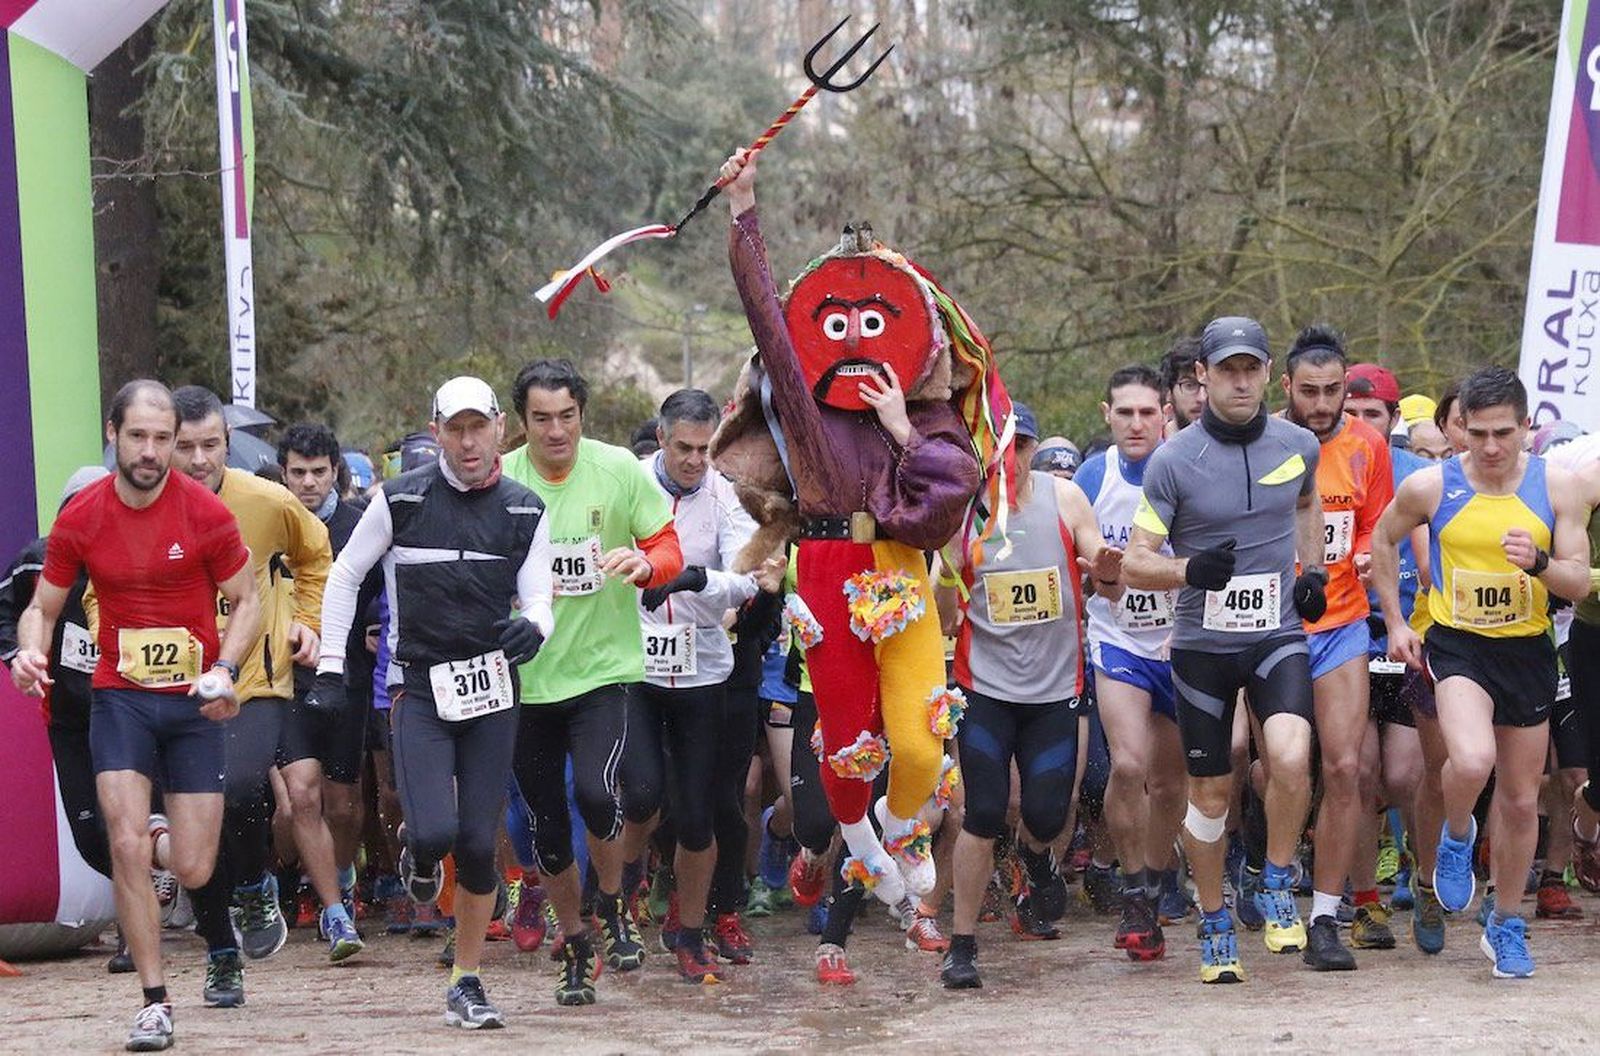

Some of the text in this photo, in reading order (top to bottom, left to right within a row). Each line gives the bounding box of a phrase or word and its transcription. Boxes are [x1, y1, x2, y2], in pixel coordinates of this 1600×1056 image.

[551, 556, 586, 577] 416
[1011, 583, 1037, 605] 20
[1126, 593, 1158, 613] 421
[1225, 588, 1264, 611] 468
[1474, 586, 1512, 608] 104
[141, 643, 179, 667] 122
[646, 636, 677, 657] 371
[453, 669, 491, 697] 370
